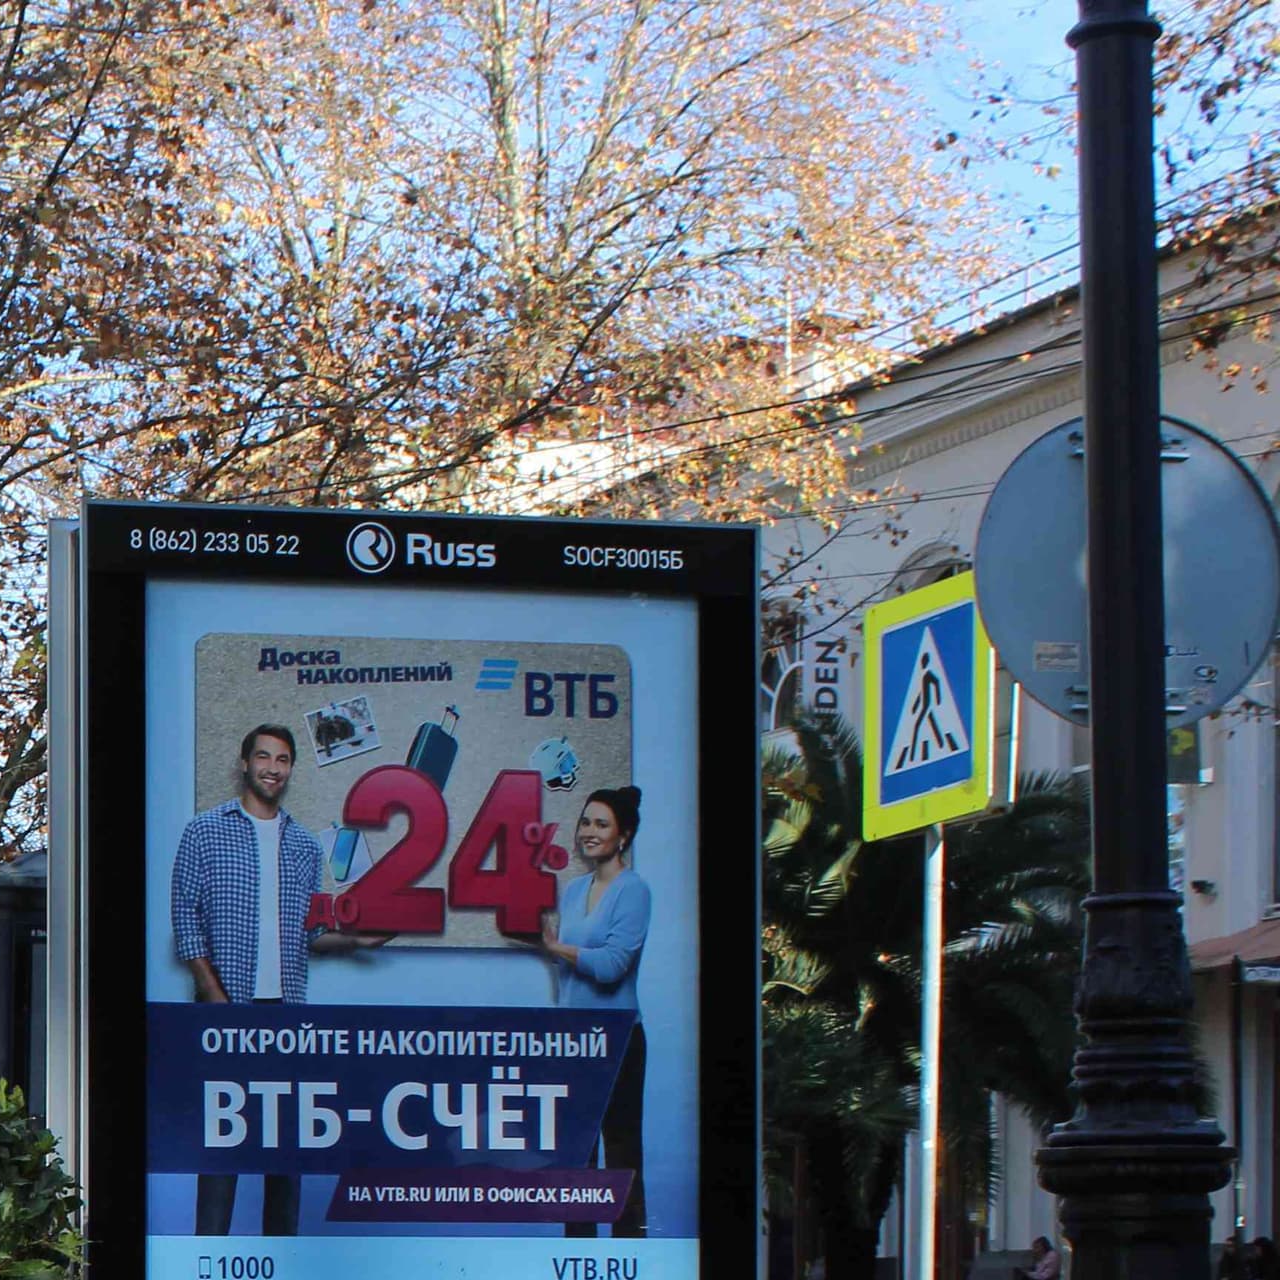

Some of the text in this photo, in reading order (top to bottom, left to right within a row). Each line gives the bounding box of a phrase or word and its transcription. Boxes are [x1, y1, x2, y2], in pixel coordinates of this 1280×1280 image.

[130, 527, 299, 555] 8 (862) 233 05 22
[258, 647, 341, 671] Доска
[525, 671, 619, 719] ВТБ
[202, 1023, 607, 1058] ОТКРОЙТЕ НАКОПИТЕЛЬНЫЙ
[203, 1066, 569, 1150] ВТБ-СЧЁТ
[348, 1186, 615, 1205] НА VTB.RU ИЛИ В ОФИСАХ БАНКА
[217, 1256, 275, 1280] 1000
[552, 1257, 637, 1280] VTB.RU
